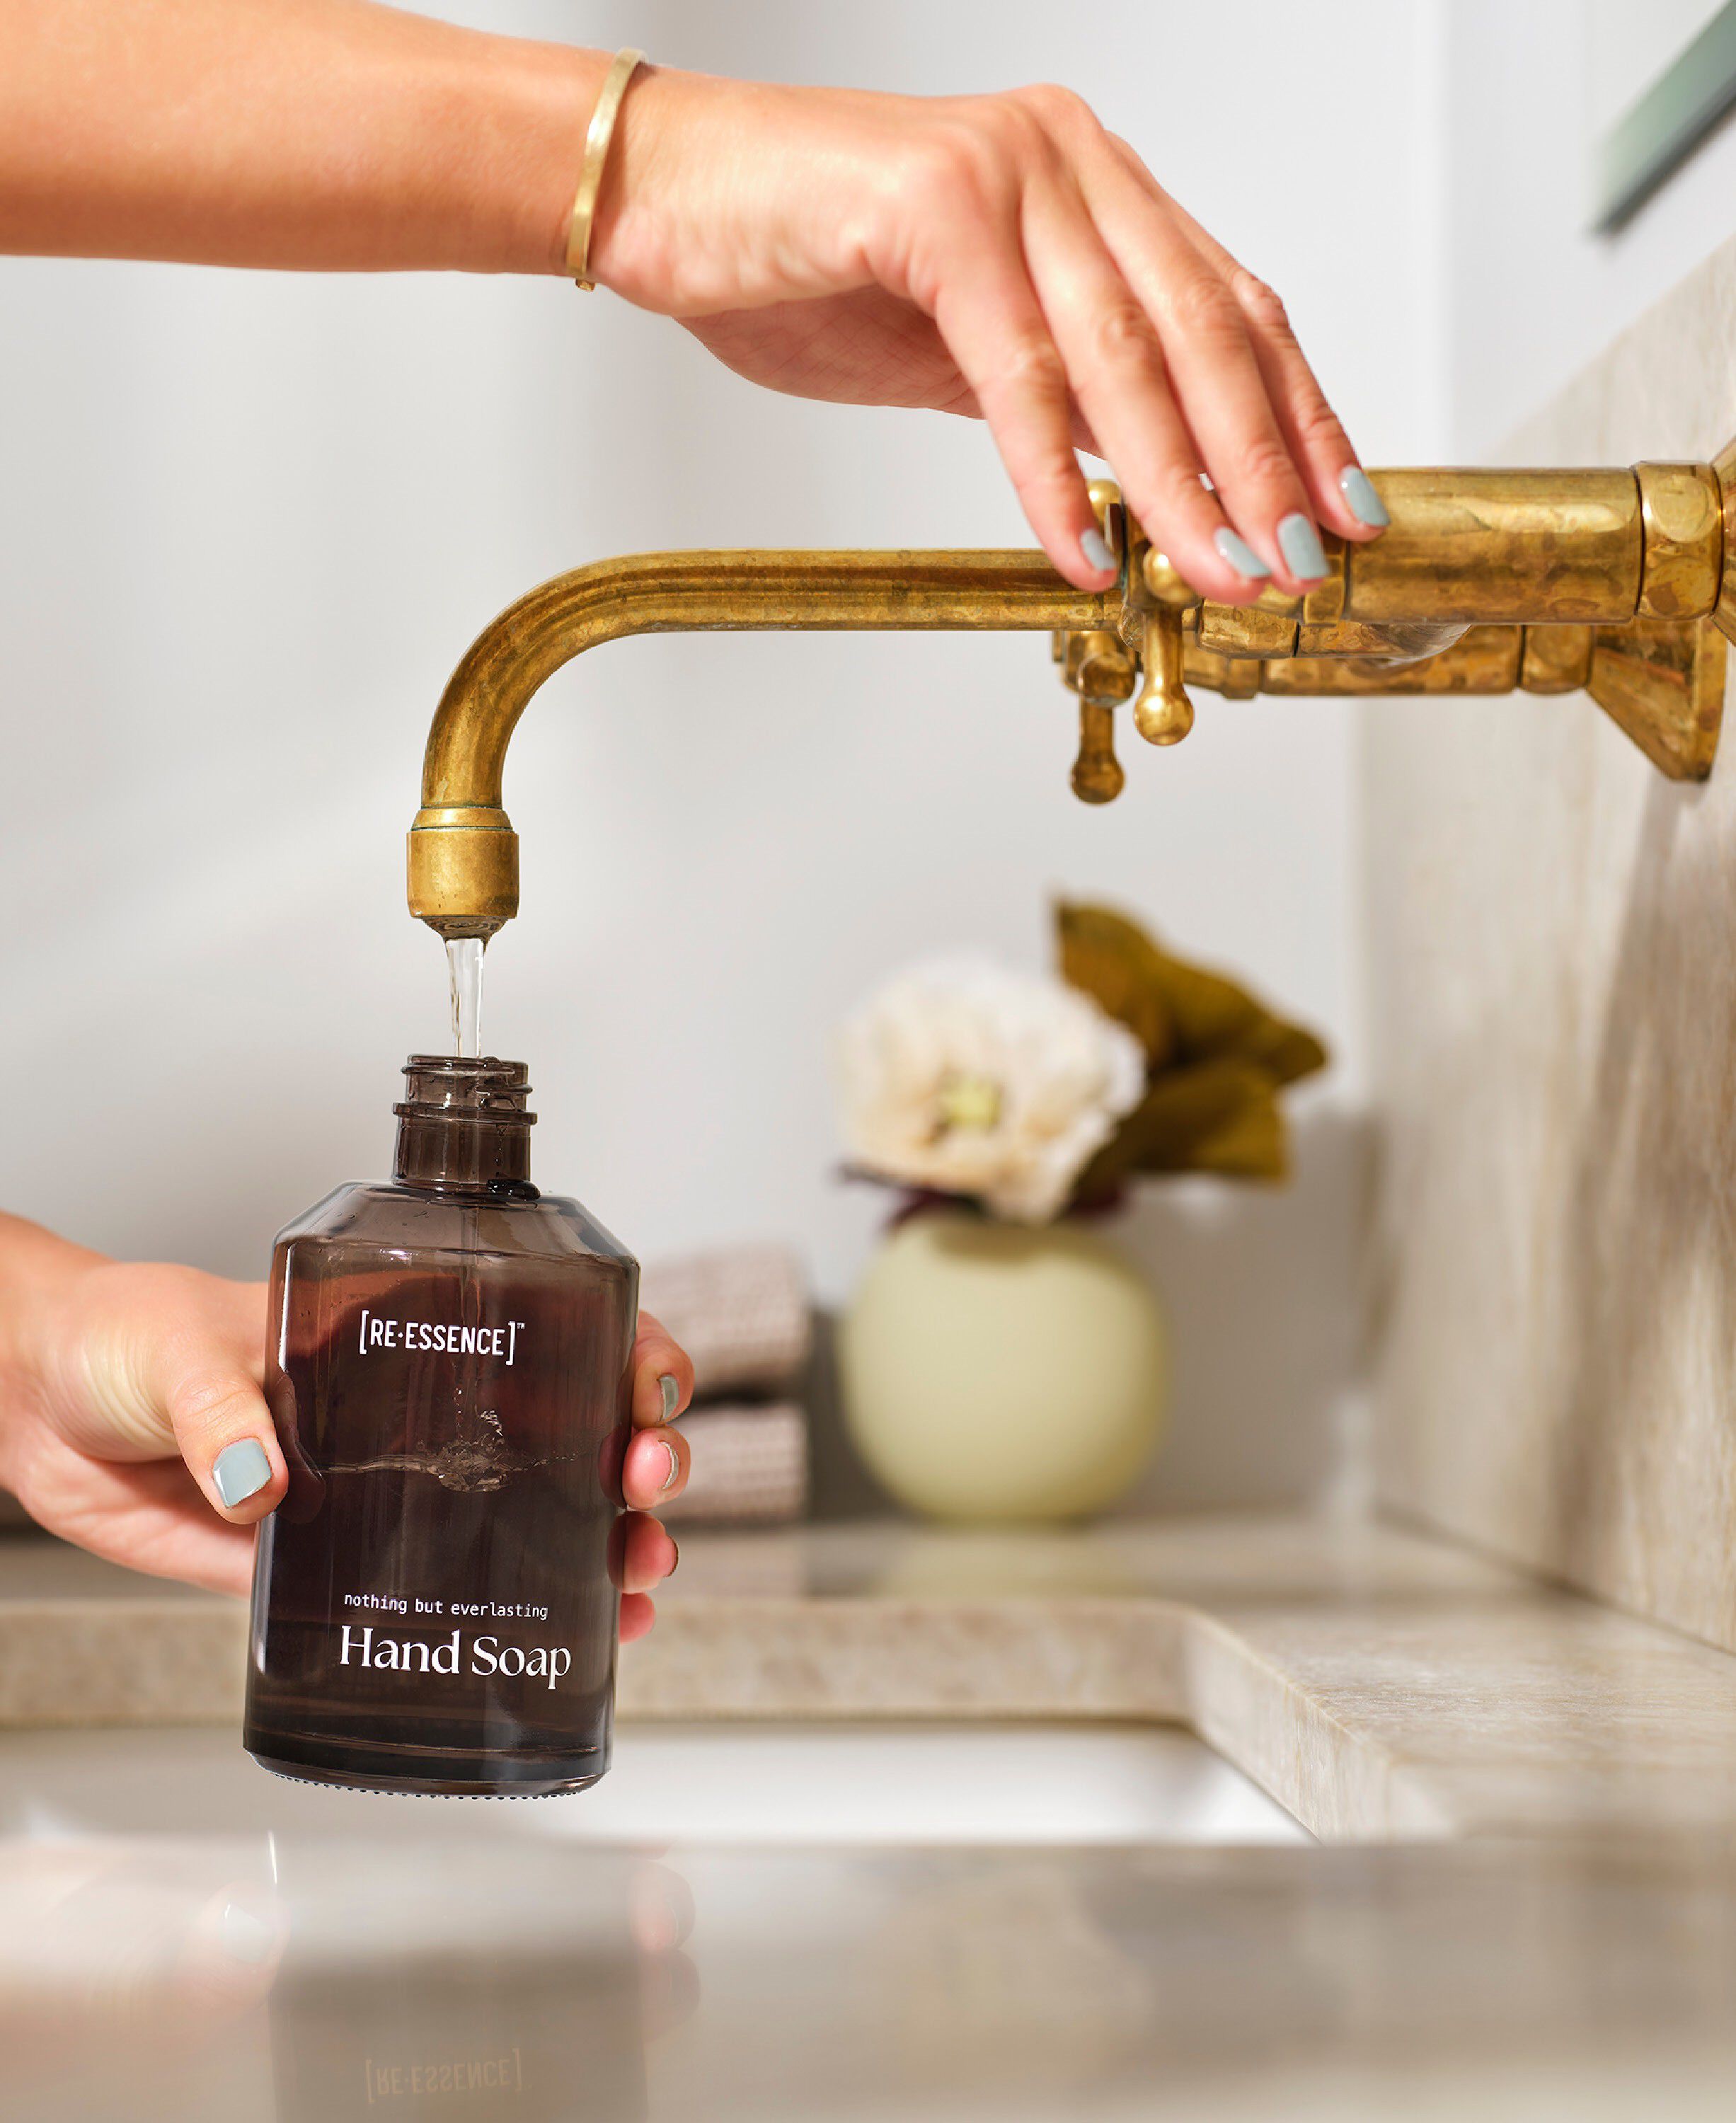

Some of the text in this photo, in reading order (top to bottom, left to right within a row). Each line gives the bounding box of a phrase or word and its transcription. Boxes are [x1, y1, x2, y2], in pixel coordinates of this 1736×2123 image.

[344, 1593, 548, 1620] nothing but everlasting
[339, 1625, 572, 1690] Hand Soap
